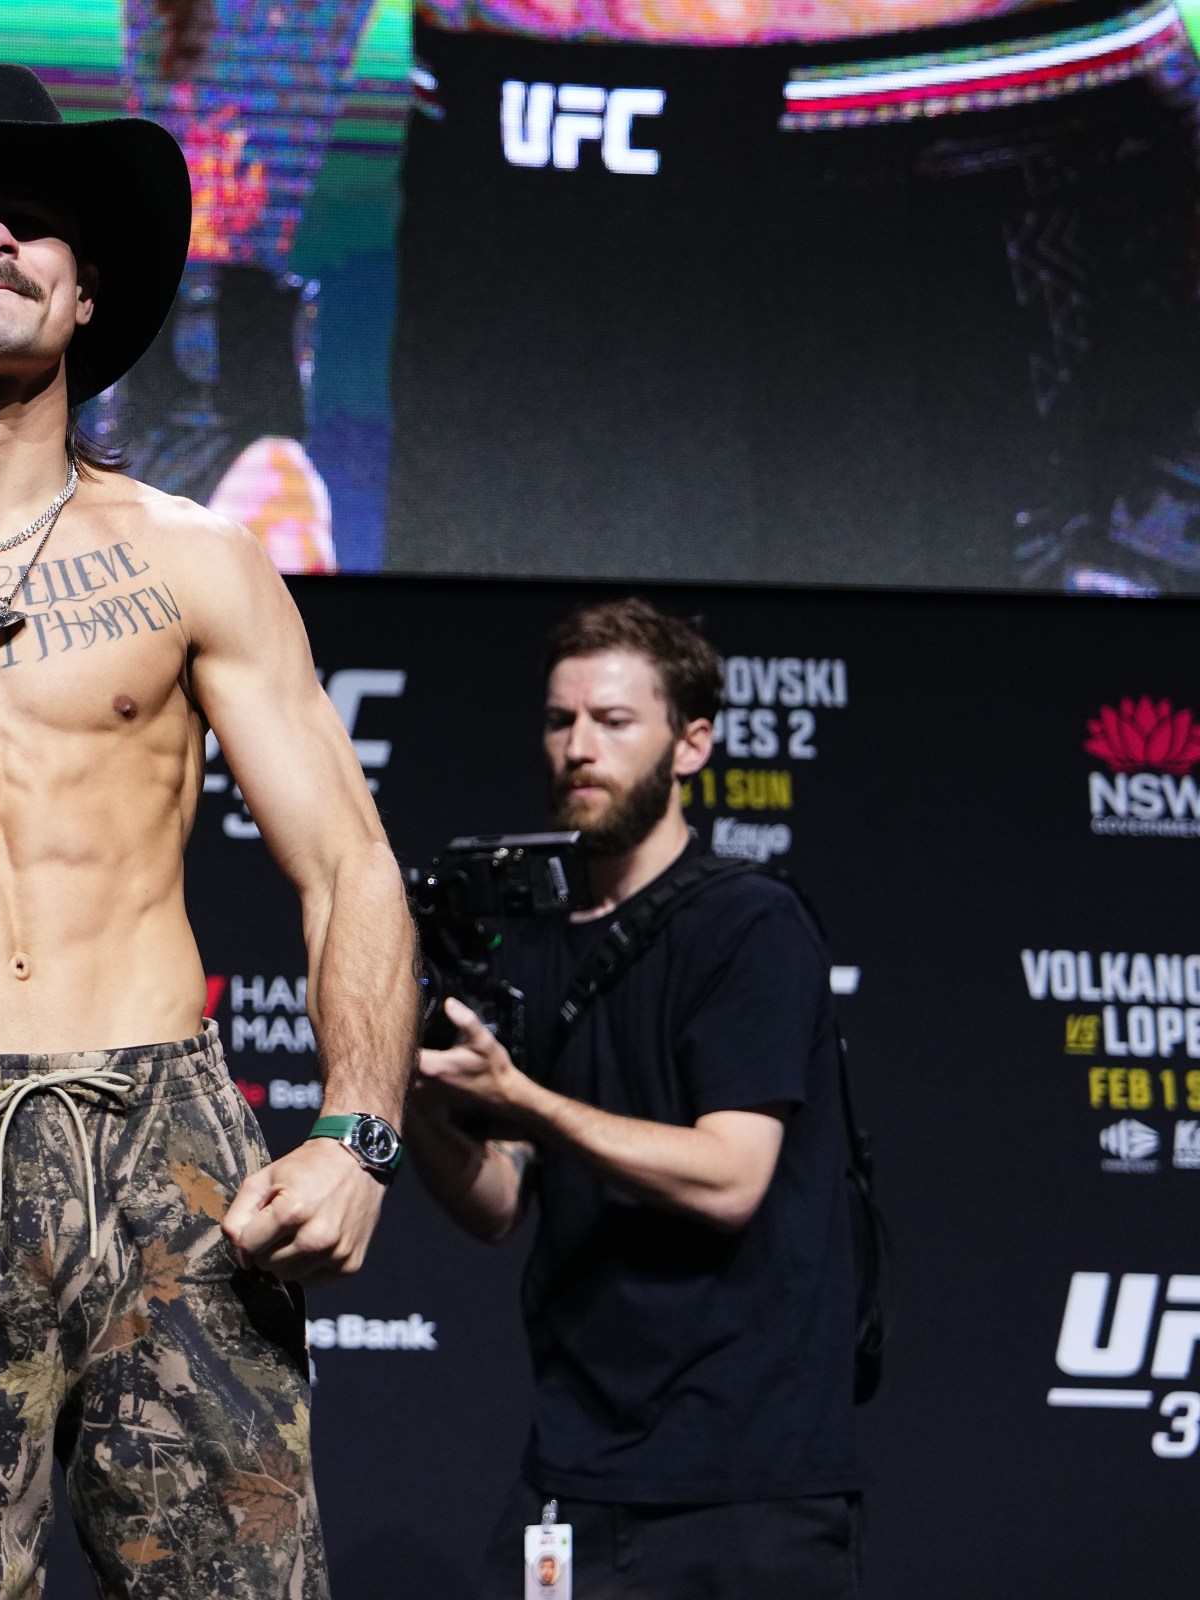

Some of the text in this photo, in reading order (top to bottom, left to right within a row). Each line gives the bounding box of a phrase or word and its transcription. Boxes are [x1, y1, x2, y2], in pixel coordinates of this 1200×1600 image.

[502, 80, 667, 175] UFC
[48, 581, 186, 650] HAPPEN
[720, 656, 847, 708] OVSKI
[787, 709, 817, 759] 2
[725, 768, 792, 811] SUN
[1089, 771, 1200, 820] NSW
[1066, 1005, 1200, 1059] VS LOPE
[1089, 1067, 1151, 1110] FEB
[1160, 1069, 1176, 1110] 1
[337, 1314, 439, 1350] Bank
